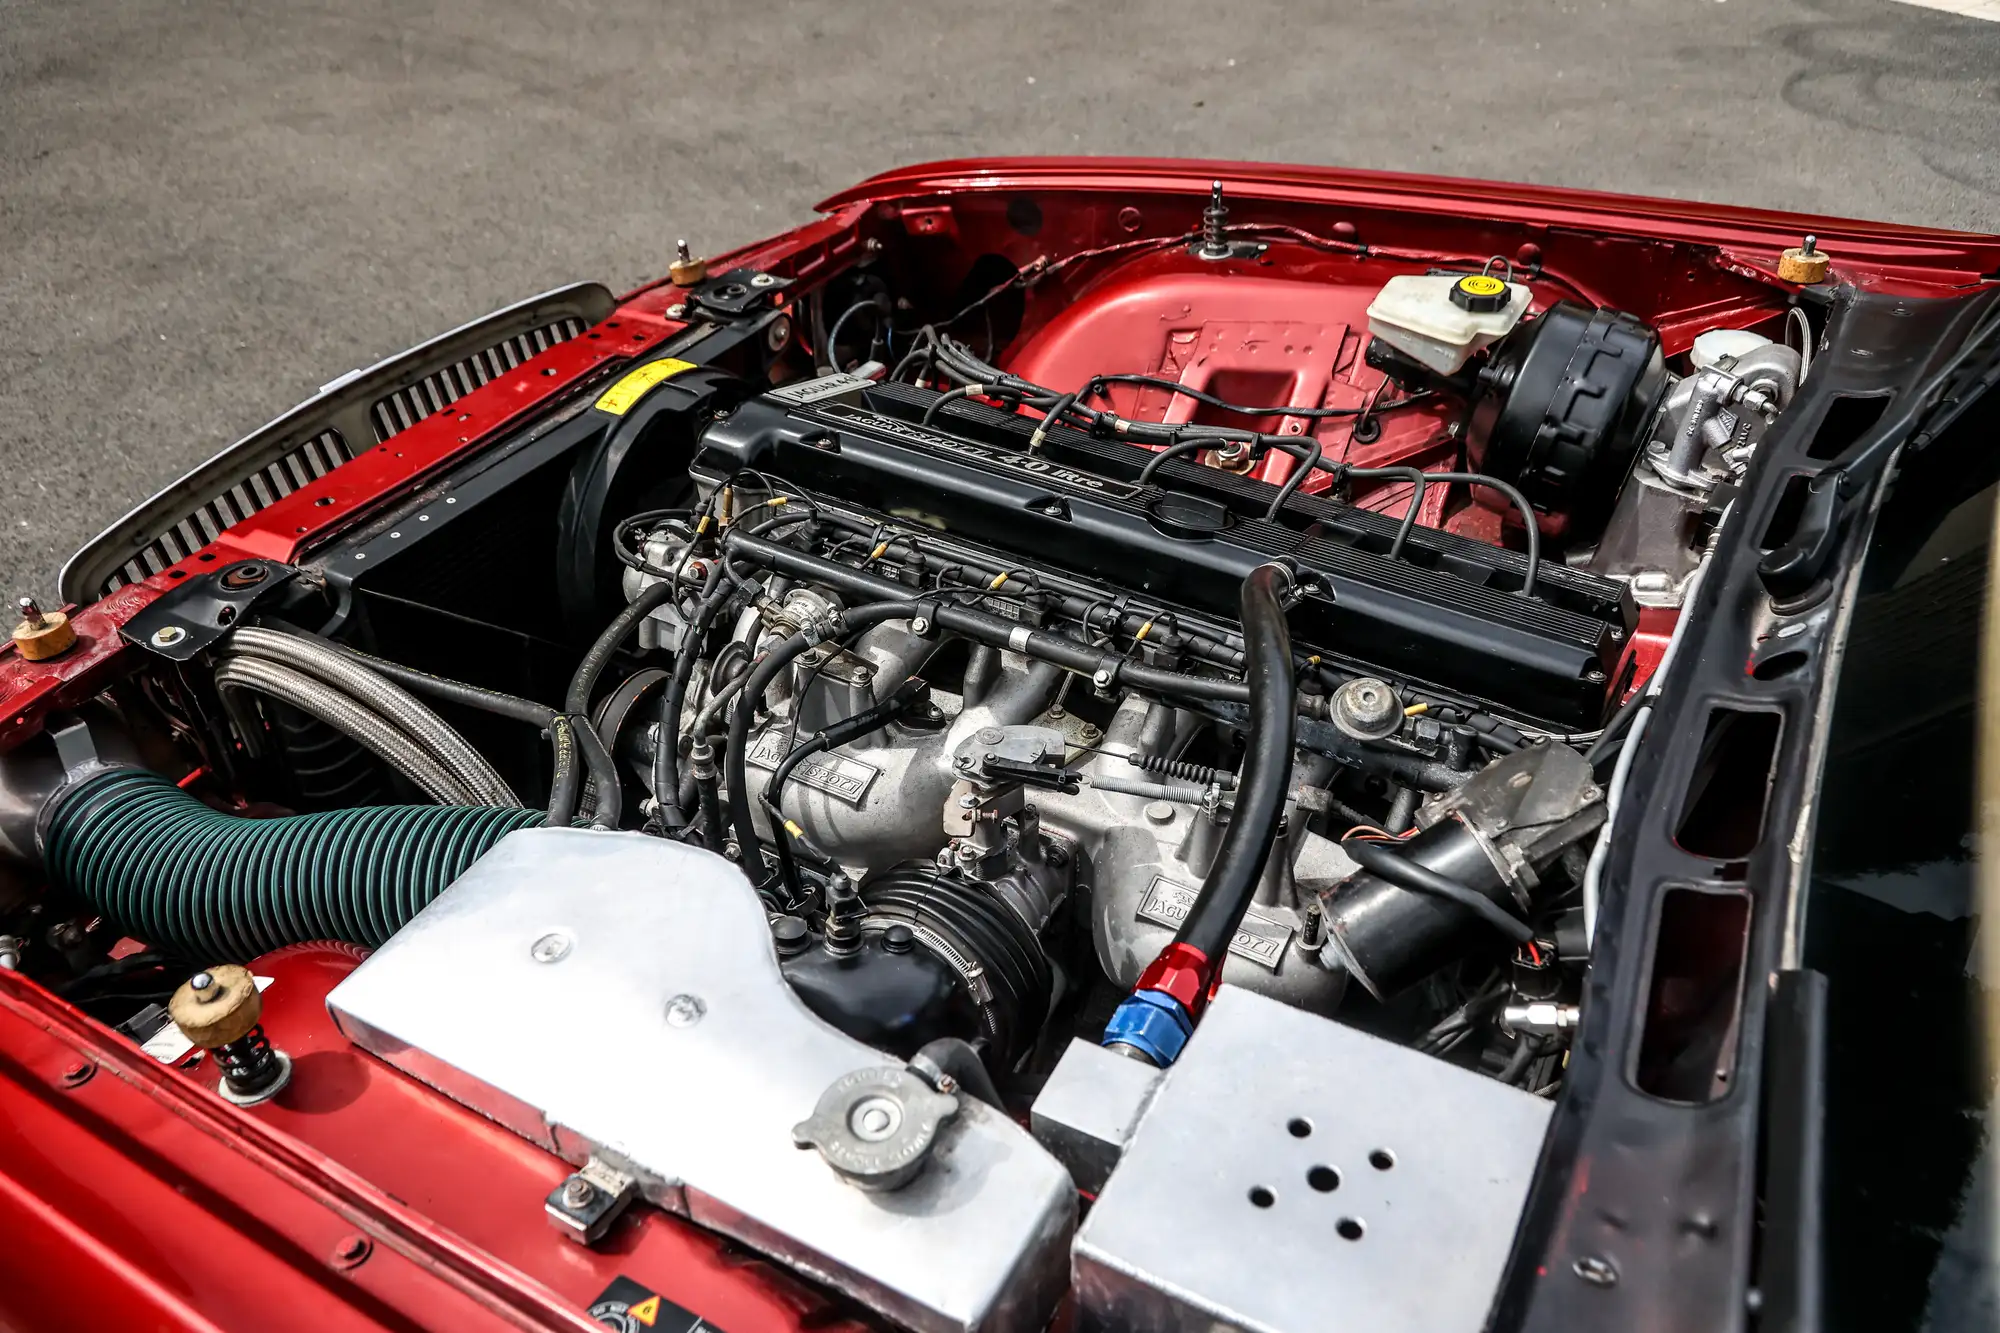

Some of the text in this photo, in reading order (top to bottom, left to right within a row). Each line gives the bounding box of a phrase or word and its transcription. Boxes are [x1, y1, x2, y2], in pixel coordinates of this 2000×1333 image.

[842, 414, 904, 433] JAGUAR
[1051, 469, 1104, 488] litre
[808, 767, 859, 793] SPORT
[1147, 898, 1188, 921] JAGU
